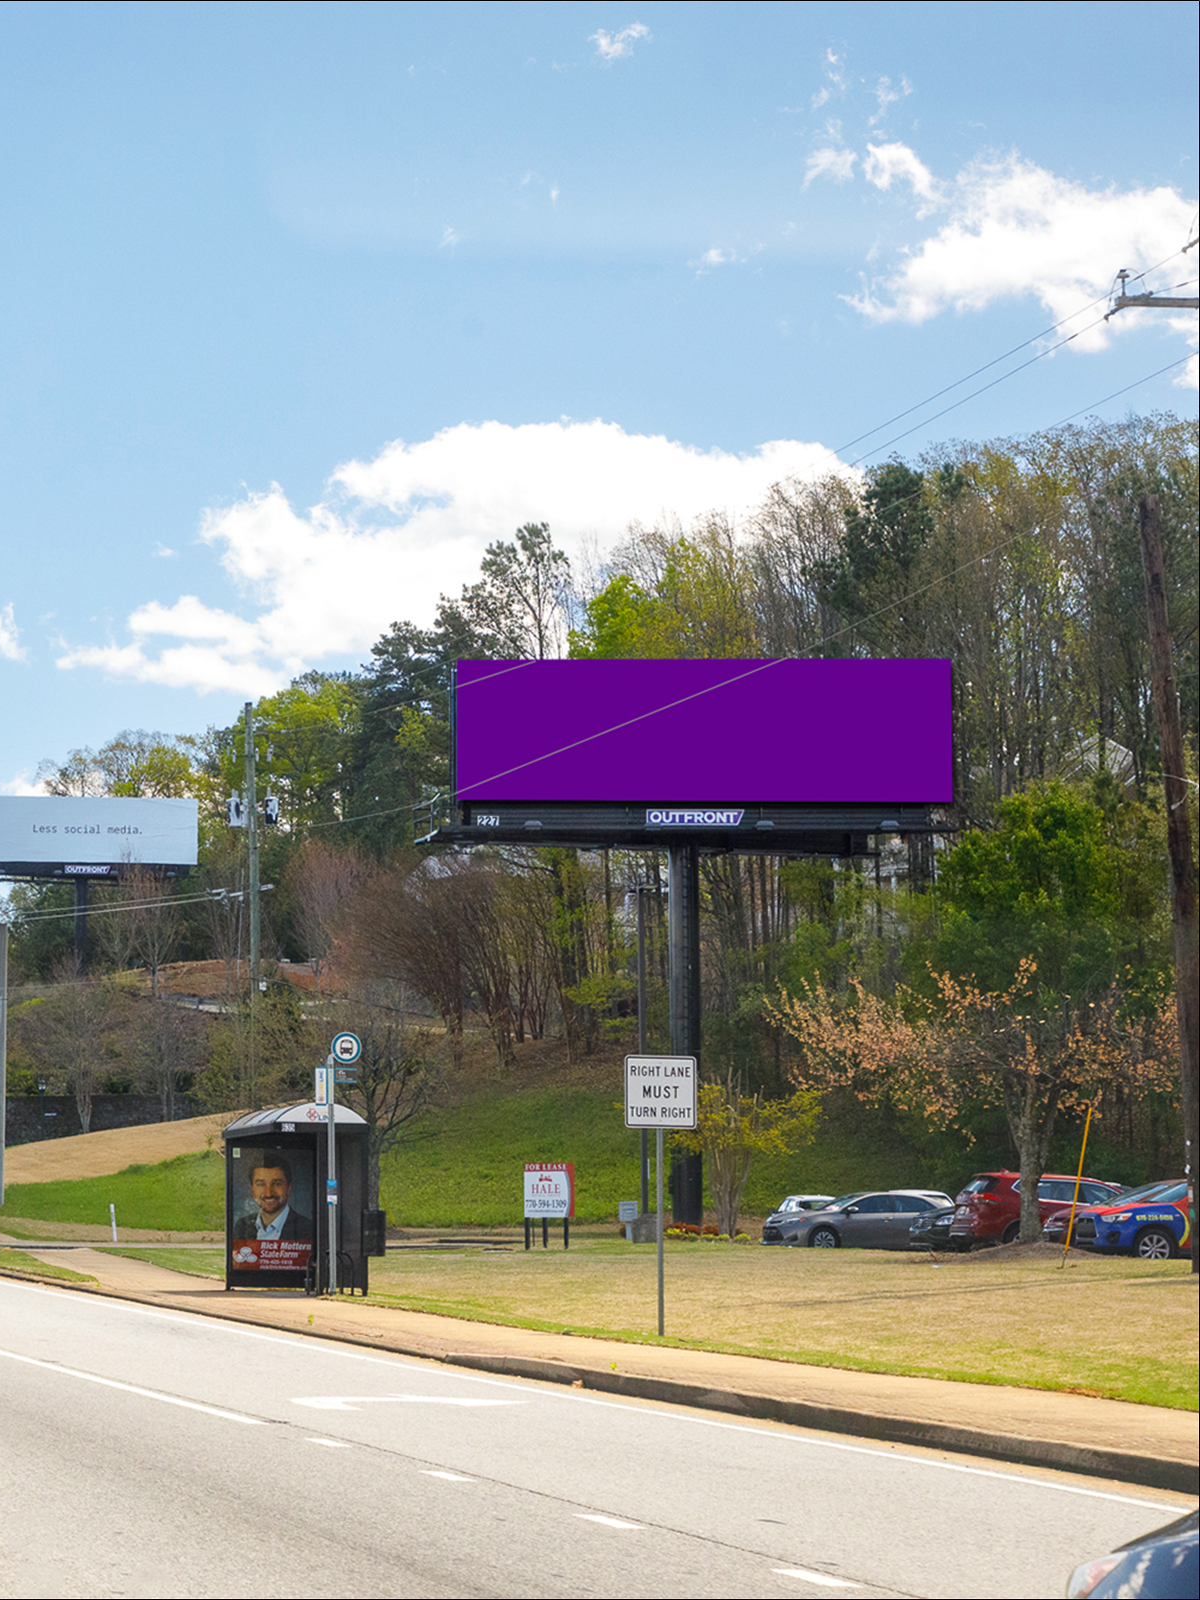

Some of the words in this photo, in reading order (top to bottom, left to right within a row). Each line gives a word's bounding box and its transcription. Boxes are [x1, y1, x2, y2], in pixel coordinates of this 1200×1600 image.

[477, 815, 499, 826] 227
[649, 811, 738, 824] OUTFRONT
[32, 824, 57, 834] Less
[64, 824, 101, 834] social
[107, 825, 143, 835] media.
[65, 865, 110, 874] OUTFRONT
[630, 1065, 661, 1077] RIGHT
[664, 1066, 691, 1078] LANE
[642, 1085, 679, 1099] MUST
[630, 1106, 657, 1117] TURN
[660, 1106, 692, 1118] RIGHT
[531, 1184, 561, 1194] HALE
[525, 1199, 567, 1208] 770-594-1309
[260, 1241, 278, 1250] Rick
[280, 1242, 312, 1250] Mottern
